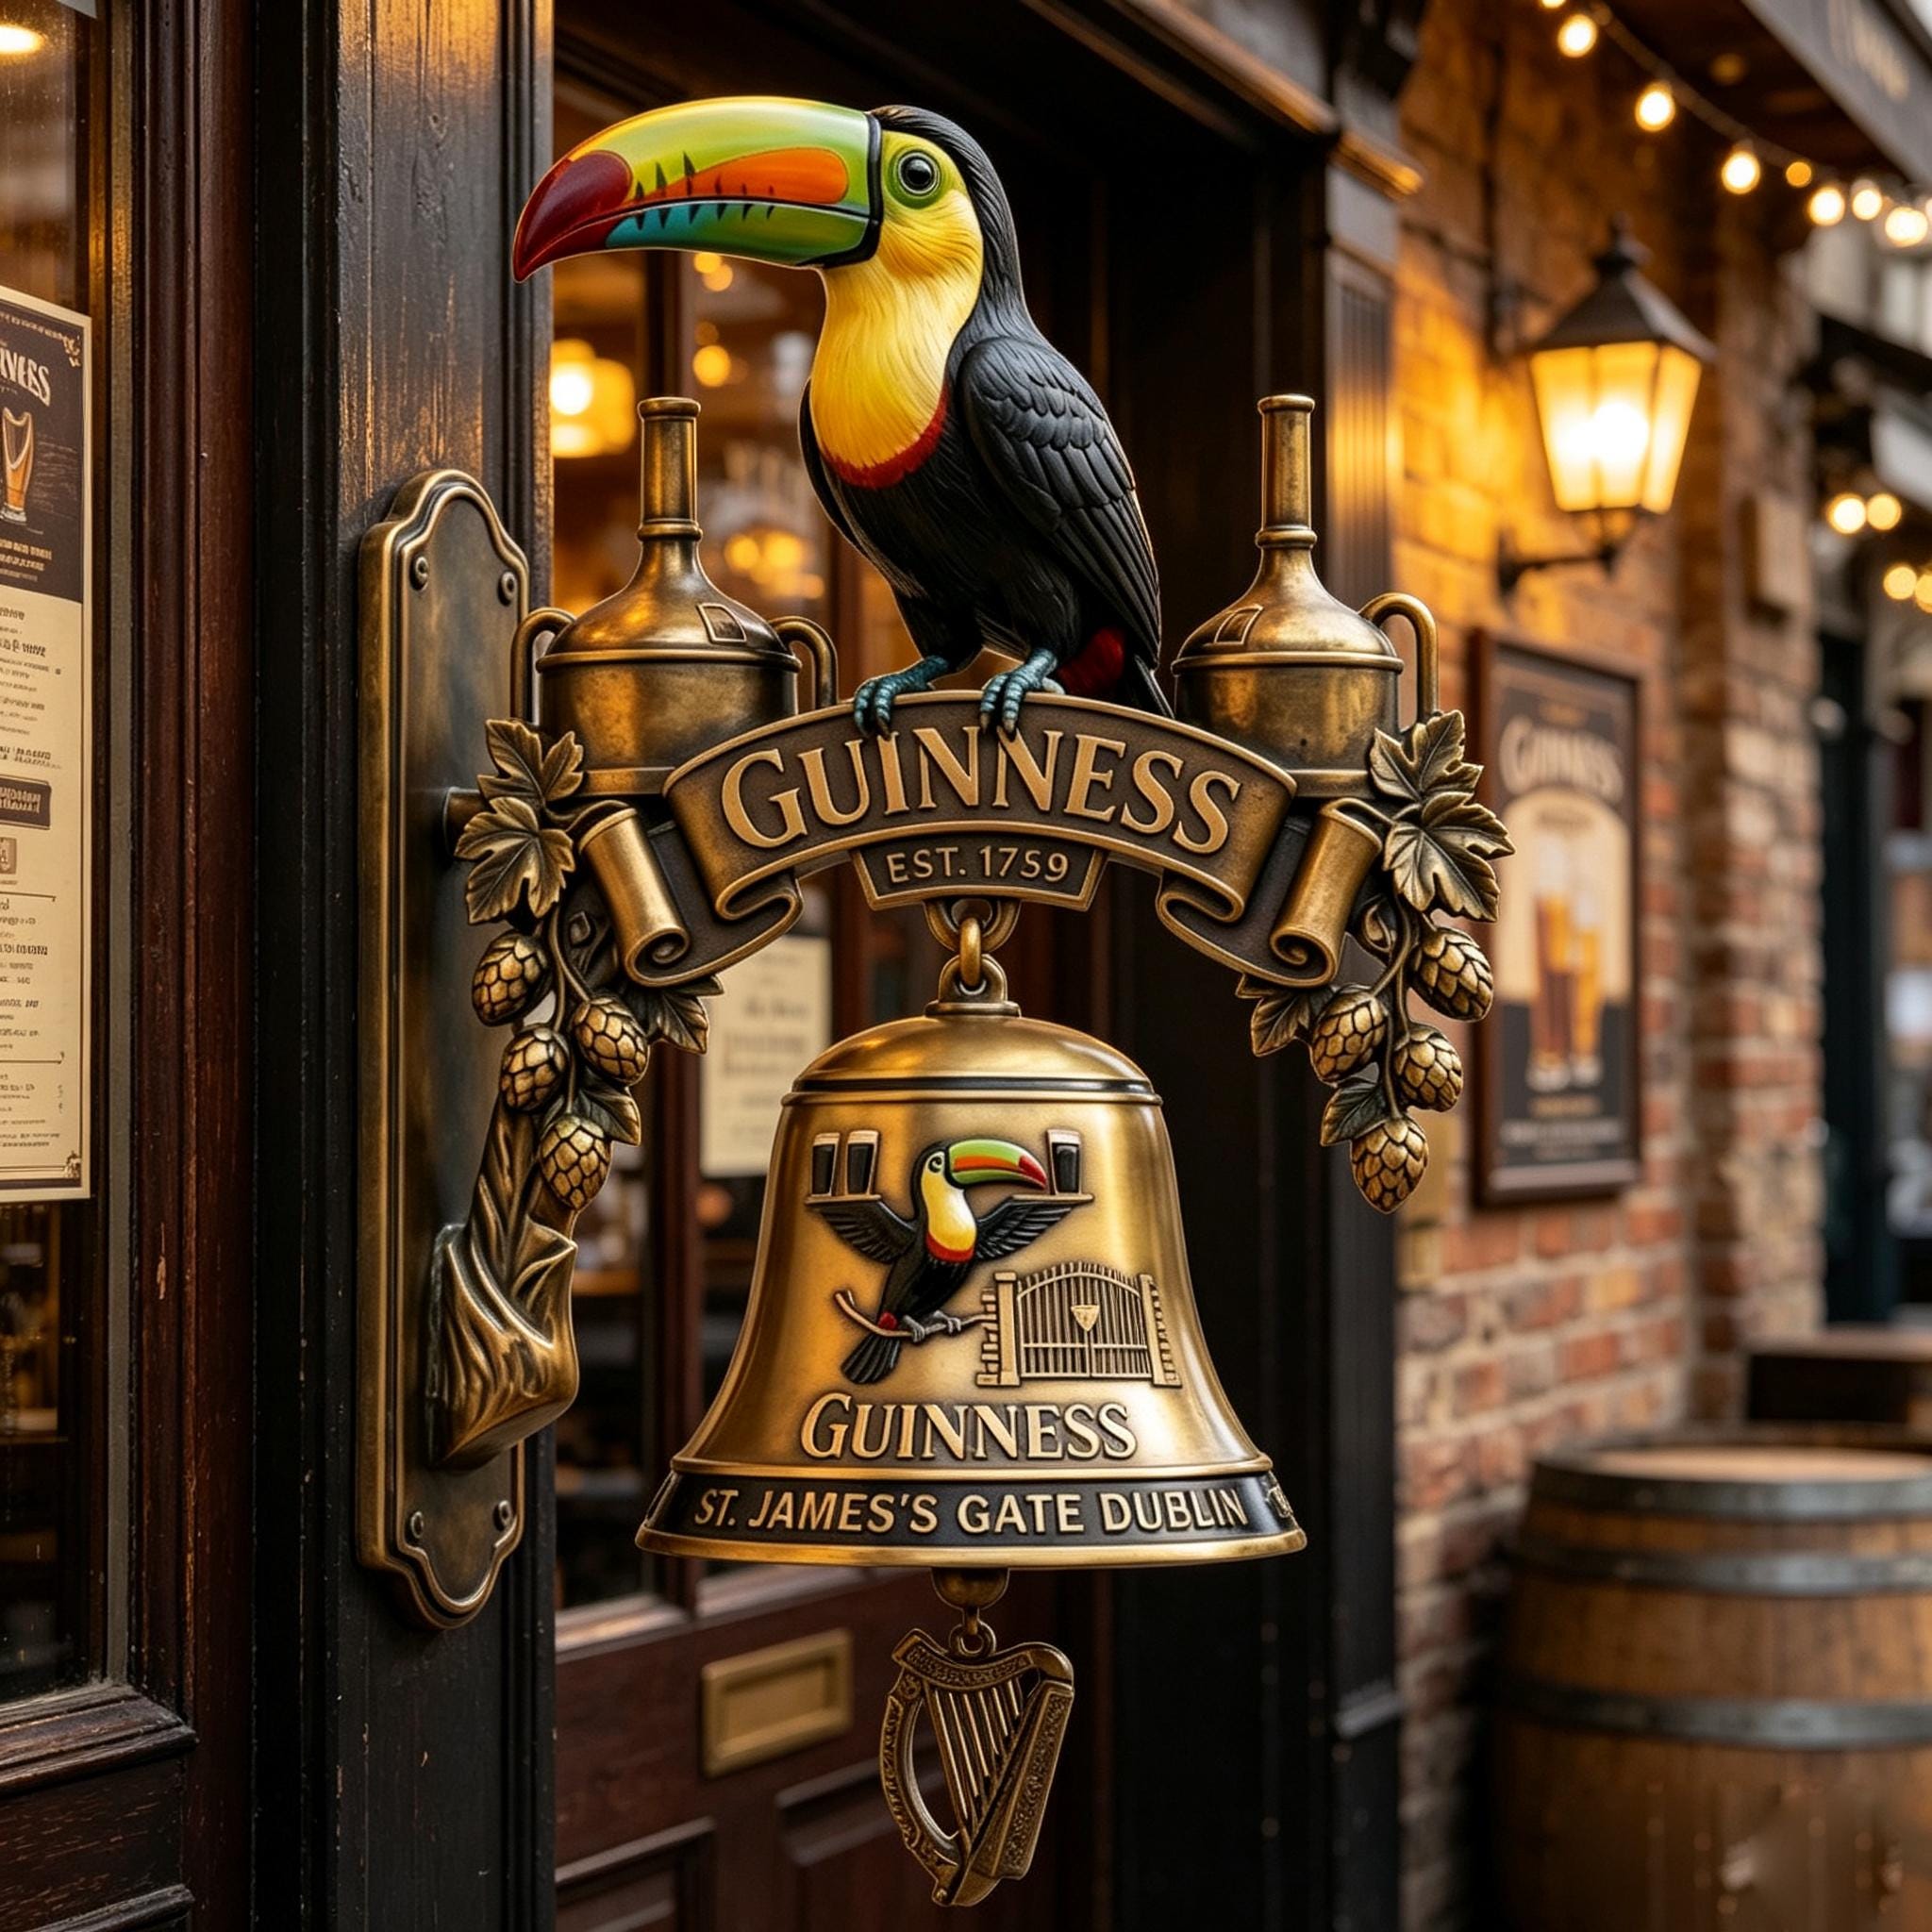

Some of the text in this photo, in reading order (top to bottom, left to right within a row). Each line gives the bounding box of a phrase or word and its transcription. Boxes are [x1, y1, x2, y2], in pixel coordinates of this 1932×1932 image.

[721, 725, 1241, 854] GUINNESS
[886, 845, 1069, 884] EST. 1759
[800, 1391, 1138, 1460] GUINNESS
[693, 1488, 1249, 1534] ST. JAMES'S GATE DUBLIN
